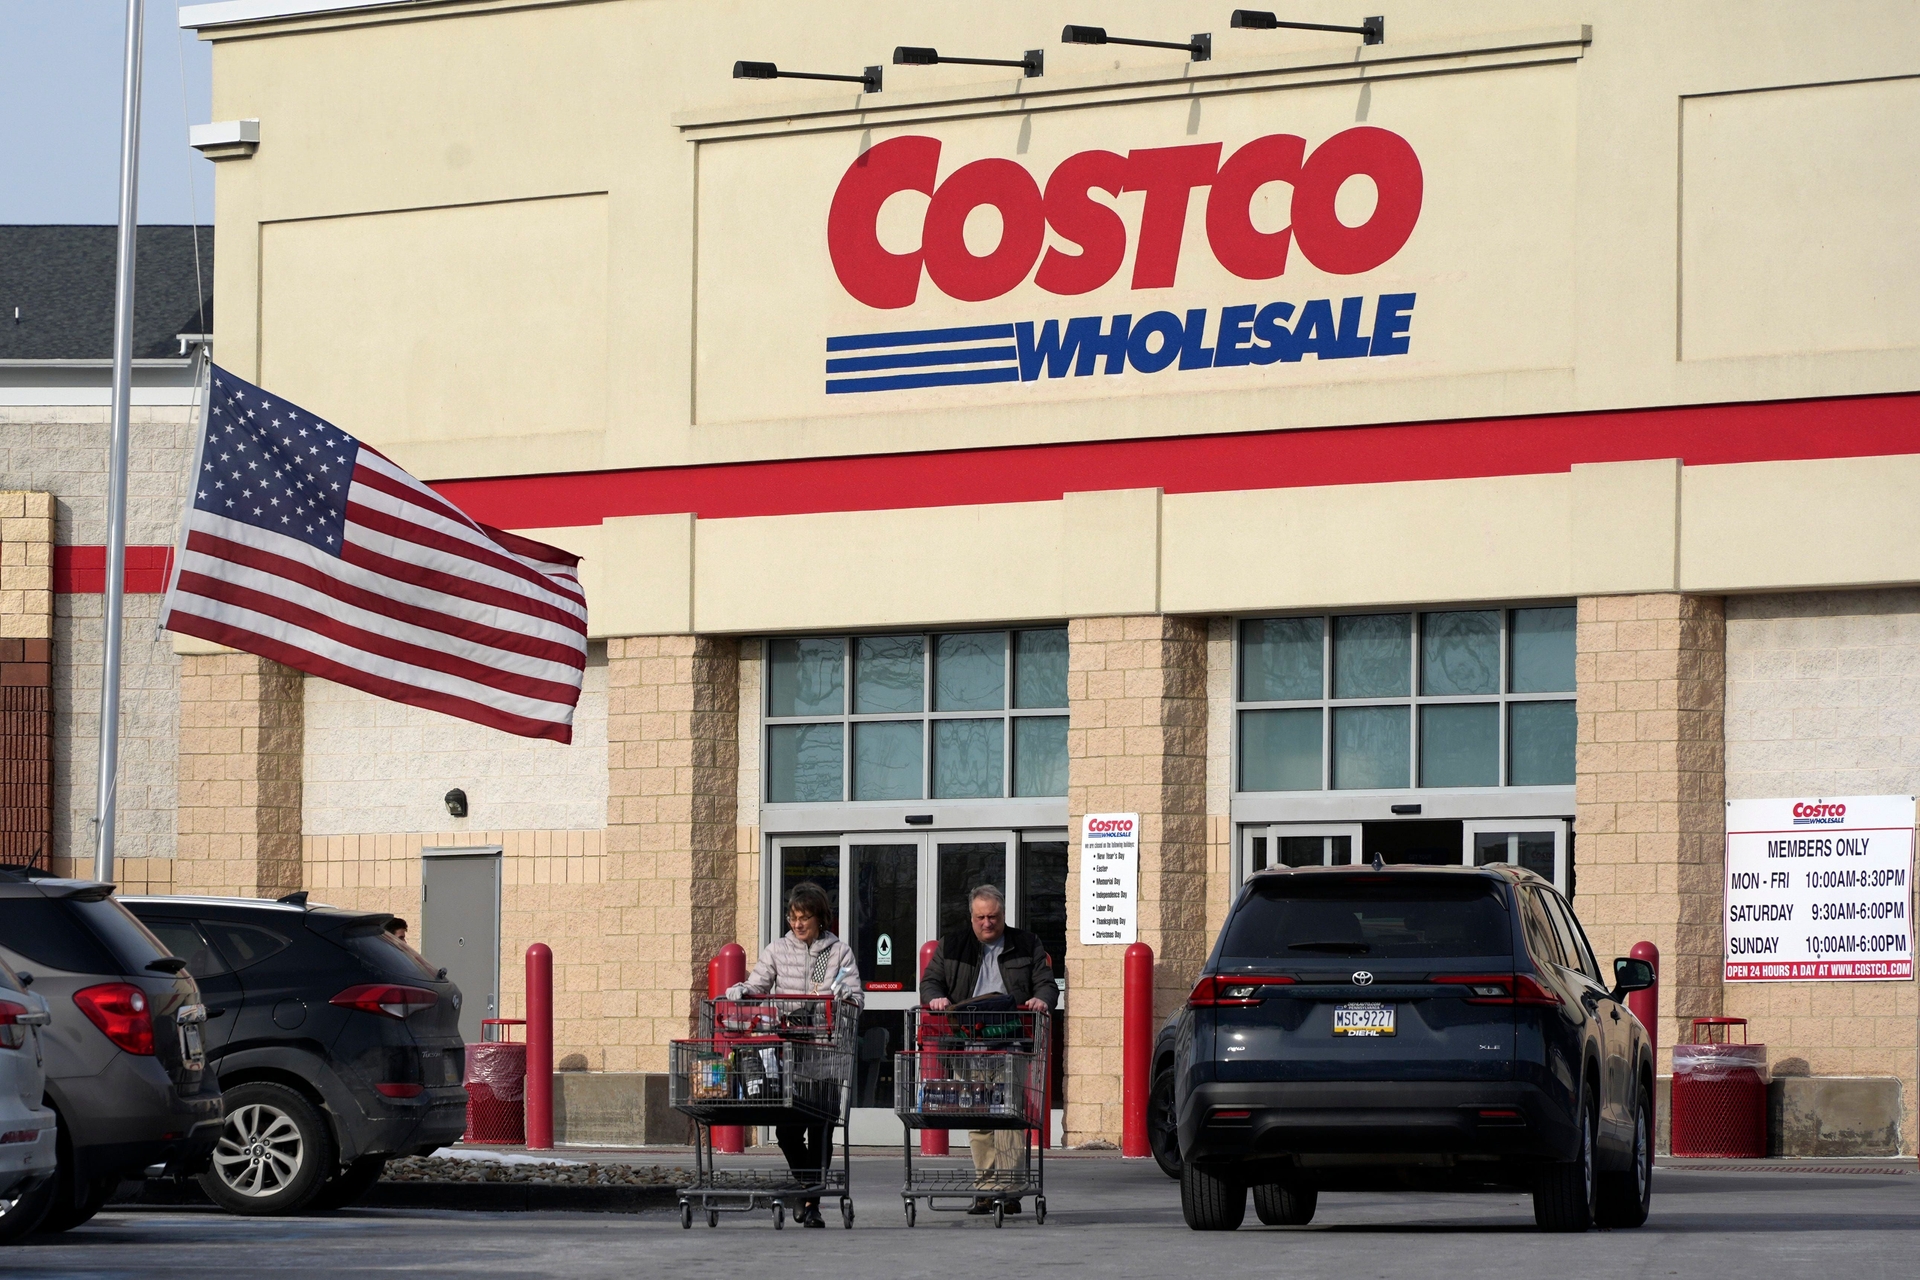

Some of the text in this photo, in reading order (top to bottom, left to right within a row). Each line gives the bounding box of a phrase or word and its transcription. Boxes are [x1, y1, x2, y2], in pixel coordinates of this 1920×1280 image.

[827, 125, 1424, 309] COSTCO
[1017, 292, 1416, 383] WHOLESALE
[1793, 802, 1846, 817] COSTCO
[1088, 818, 1133, 832] COSTCO
[1768, 838, 1869, 858] MEMBERS ONLY
[1097, 852, 1105, 860] New
[1106, 852, 1118, 860] Year's
[1096, 864, 1108, 872] Easter
[1096, 877, 1113, 885] Memorial
[1731, 872, 1760, 890] MON
[1770, 872, 1790, 889] FRI
[1805, 869, 1905, 888] 10:00AM-8:30PM
[1096, 891, 1120, 899] Independence
[1730, 901, 1904, 922] SATURDAY 9:30AM-6:00PM
[1096, 917, 1118, 926] Thanksgiving
[1730, 934, 1907, 954] SUNDAY 10:00AM-6:00PM
[1727, 962, 1910, 977] OPEN 24 HOURS A DAY AT WWW.COSTCO.COM
